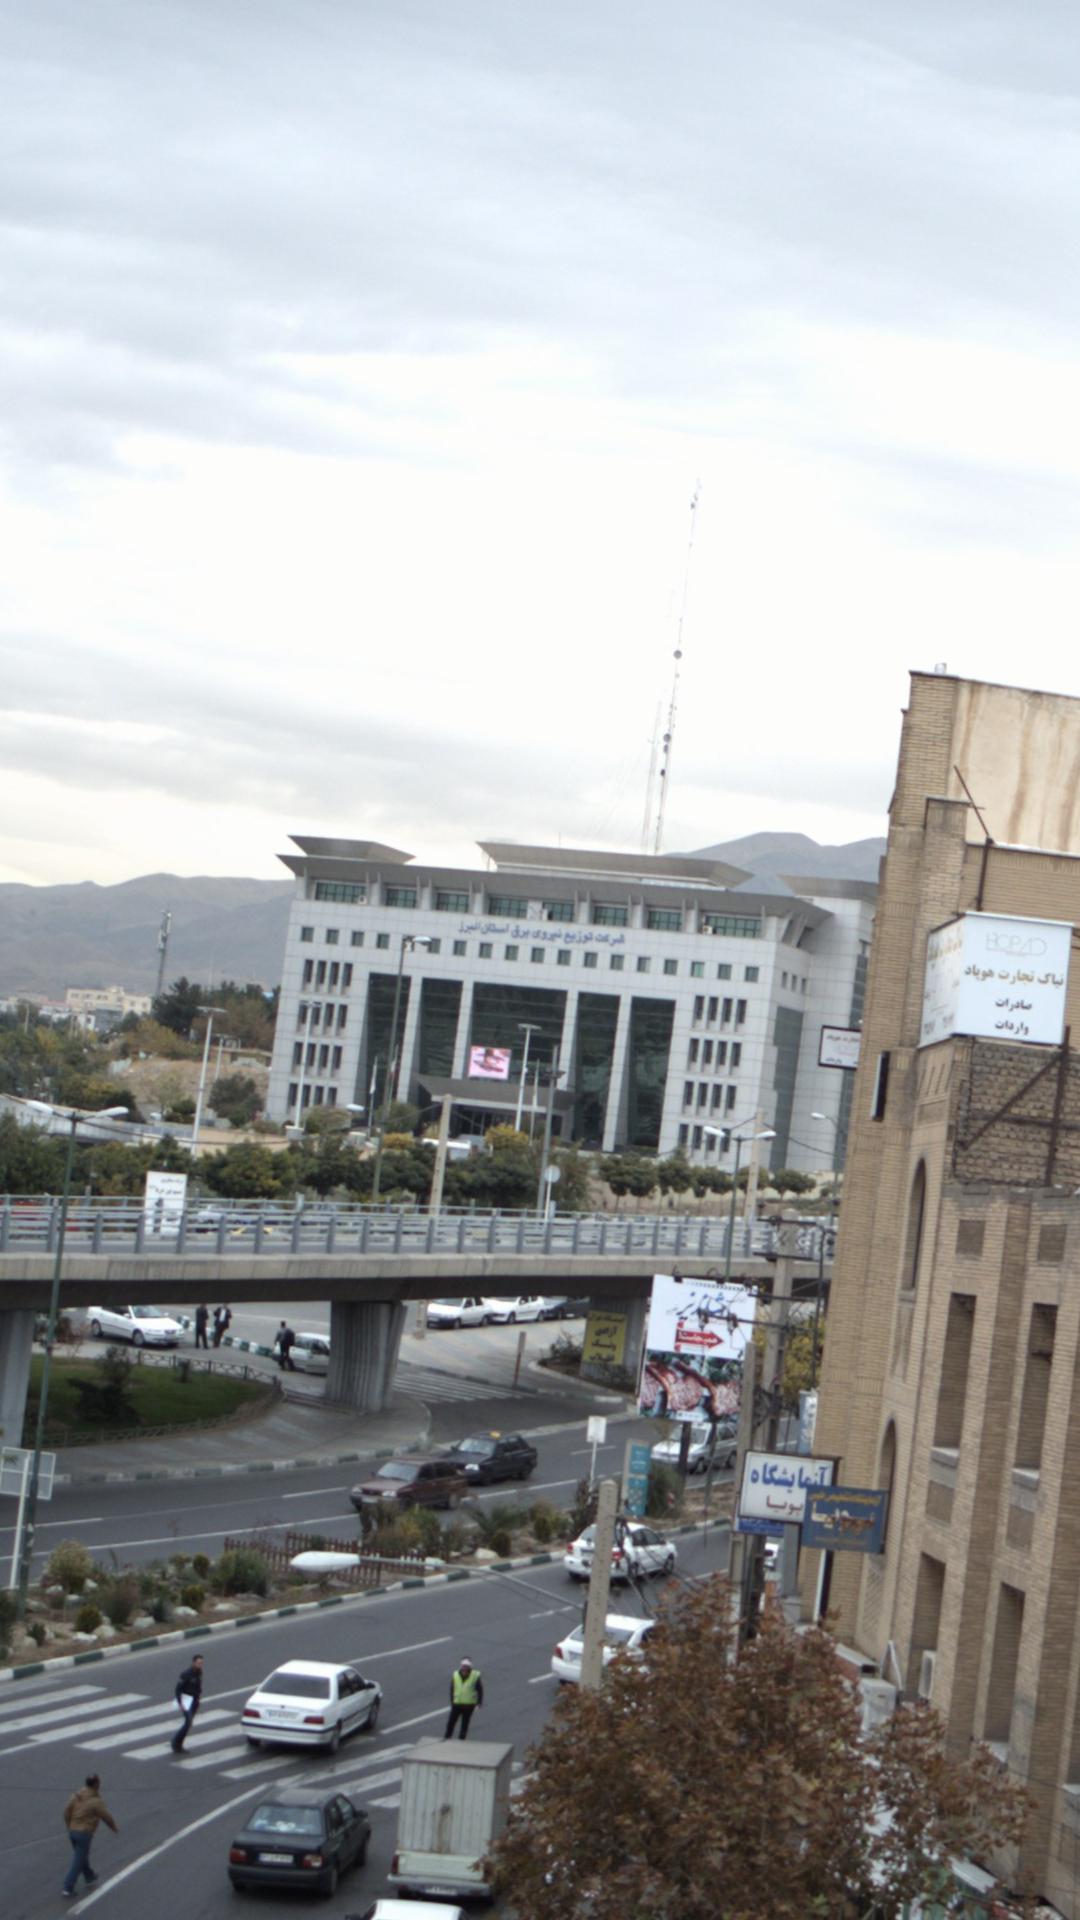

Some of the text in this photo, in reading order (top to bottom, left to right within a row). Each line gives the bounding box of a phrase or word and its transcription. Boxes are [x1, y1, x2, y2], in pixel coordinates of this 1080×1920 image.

[458, 921, 625, 946] شرکت توزیع نیروی برق استان البرز
[998, 969, 1035, 986] تجارت
[995, 998, 1032, 1012] صادرات
[994, 1020, 1029, 1035] واردات
[750, 1462, 829, 1493] آزمایشگاه
